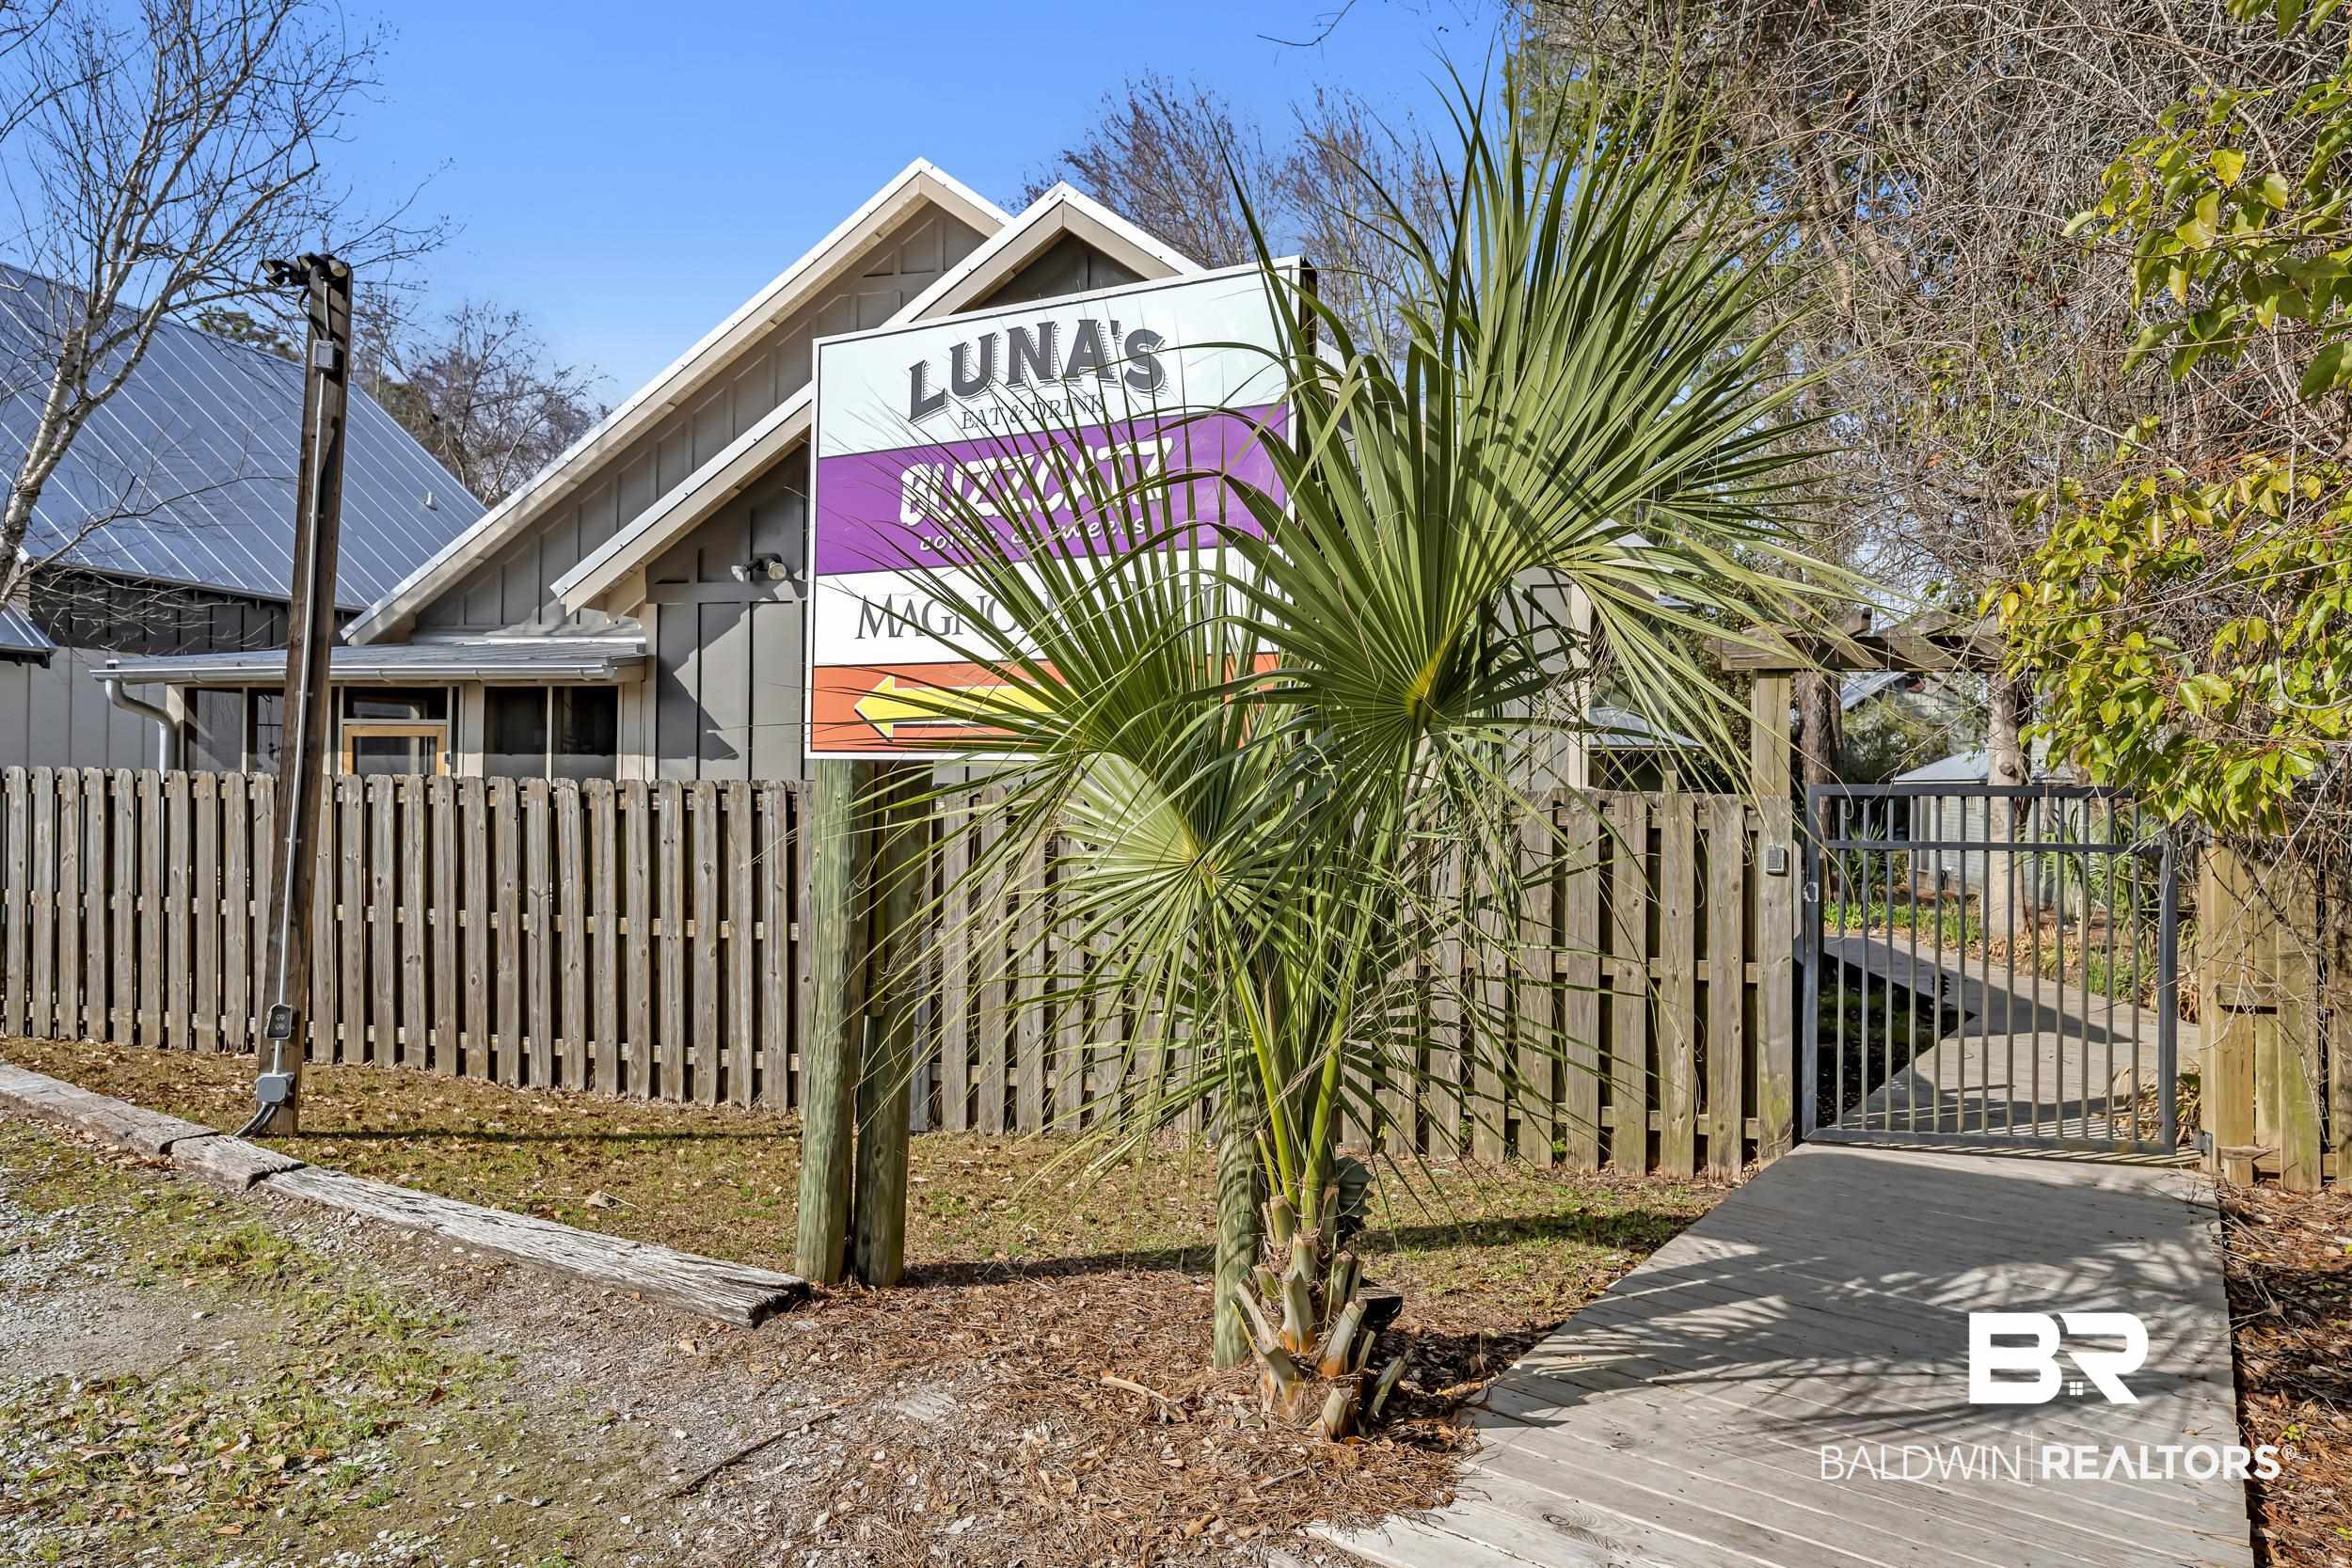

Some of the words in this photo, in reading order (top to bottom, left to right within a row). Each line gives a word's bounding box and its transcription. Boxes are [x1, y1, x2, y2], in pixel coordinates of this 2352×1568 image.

[909, 318, 1168, 422] LUNA'S
[961, 405, 1004, 430] EAT
[1009, 404, 1025, 423] &
[1029, 393, 1105, 421] DRINK
[899, 436, 1173, 527] BUZZCATZ
